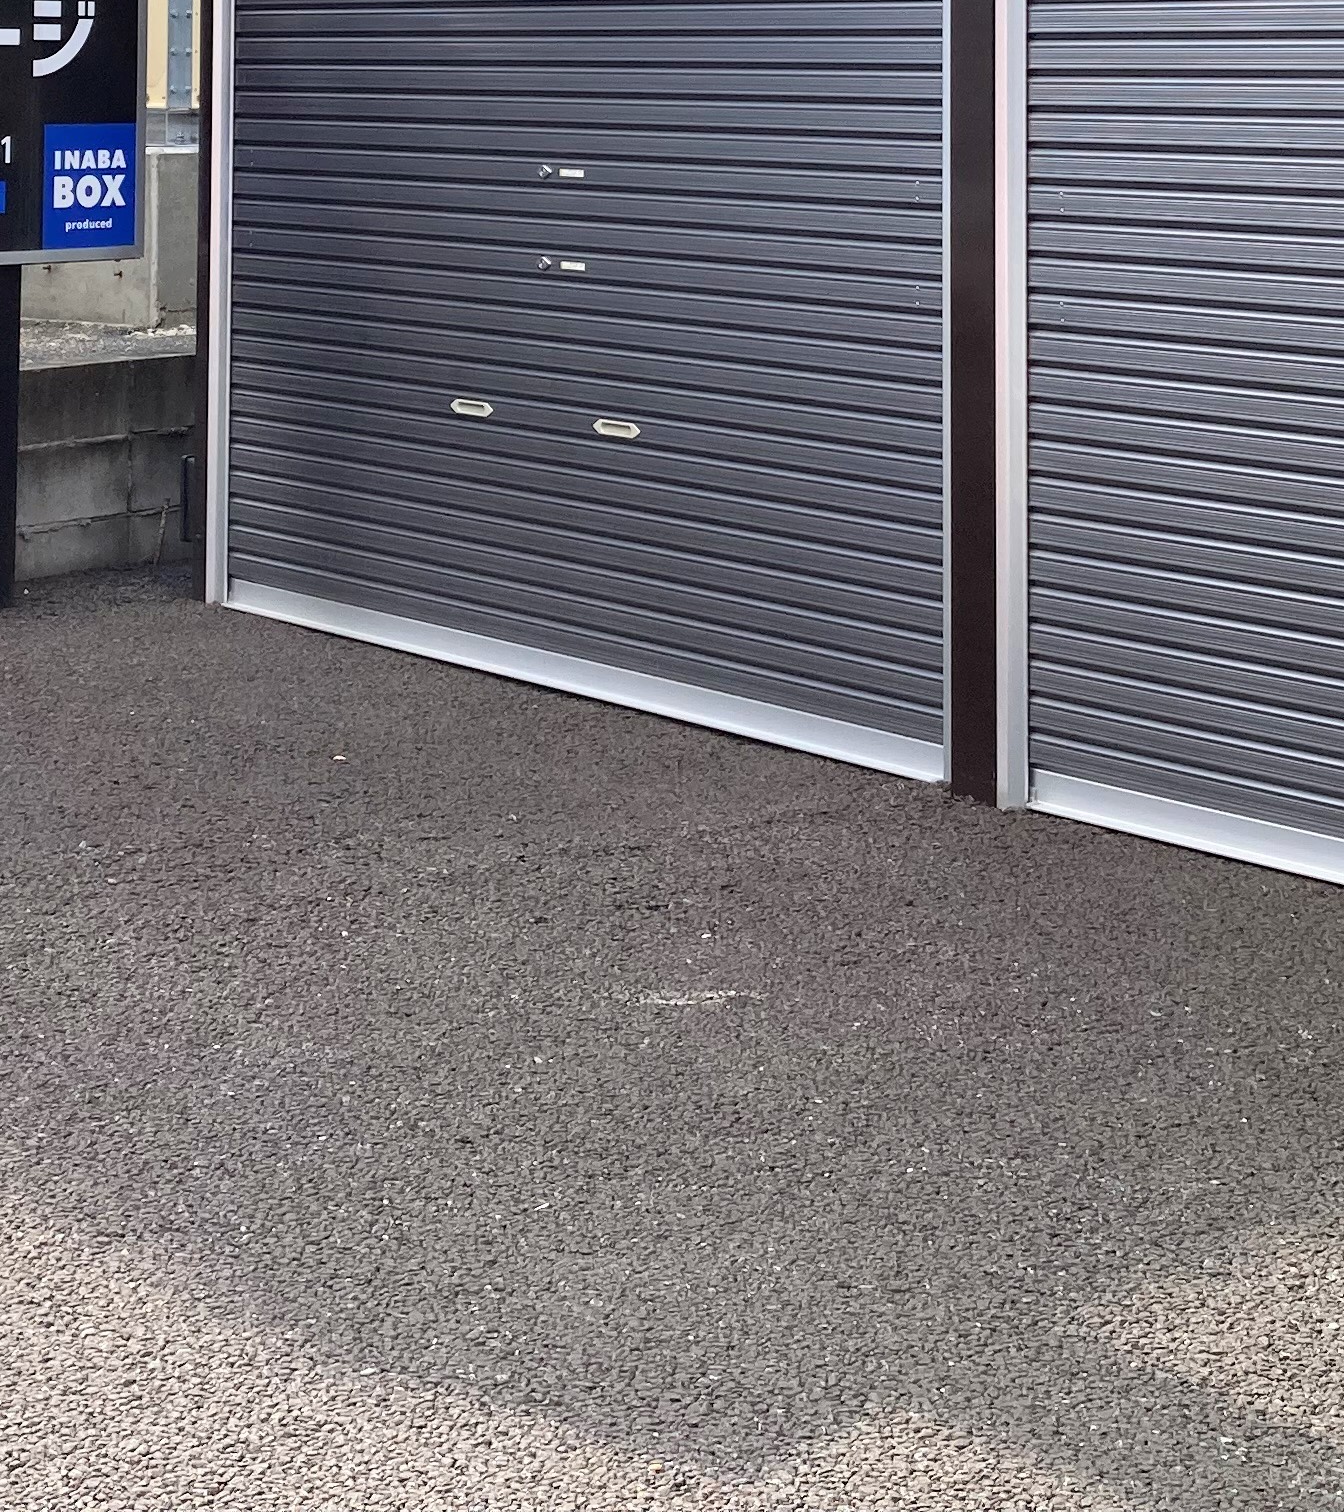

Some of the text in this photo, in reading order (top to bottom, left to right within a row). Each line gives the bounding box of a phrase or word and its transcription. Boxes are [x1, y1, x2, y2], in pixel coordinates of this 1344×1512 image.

[54, 149, 127, 170] INABA
[53, 174, 126, 209] BOX
[65, 217, 113, 233] produced
